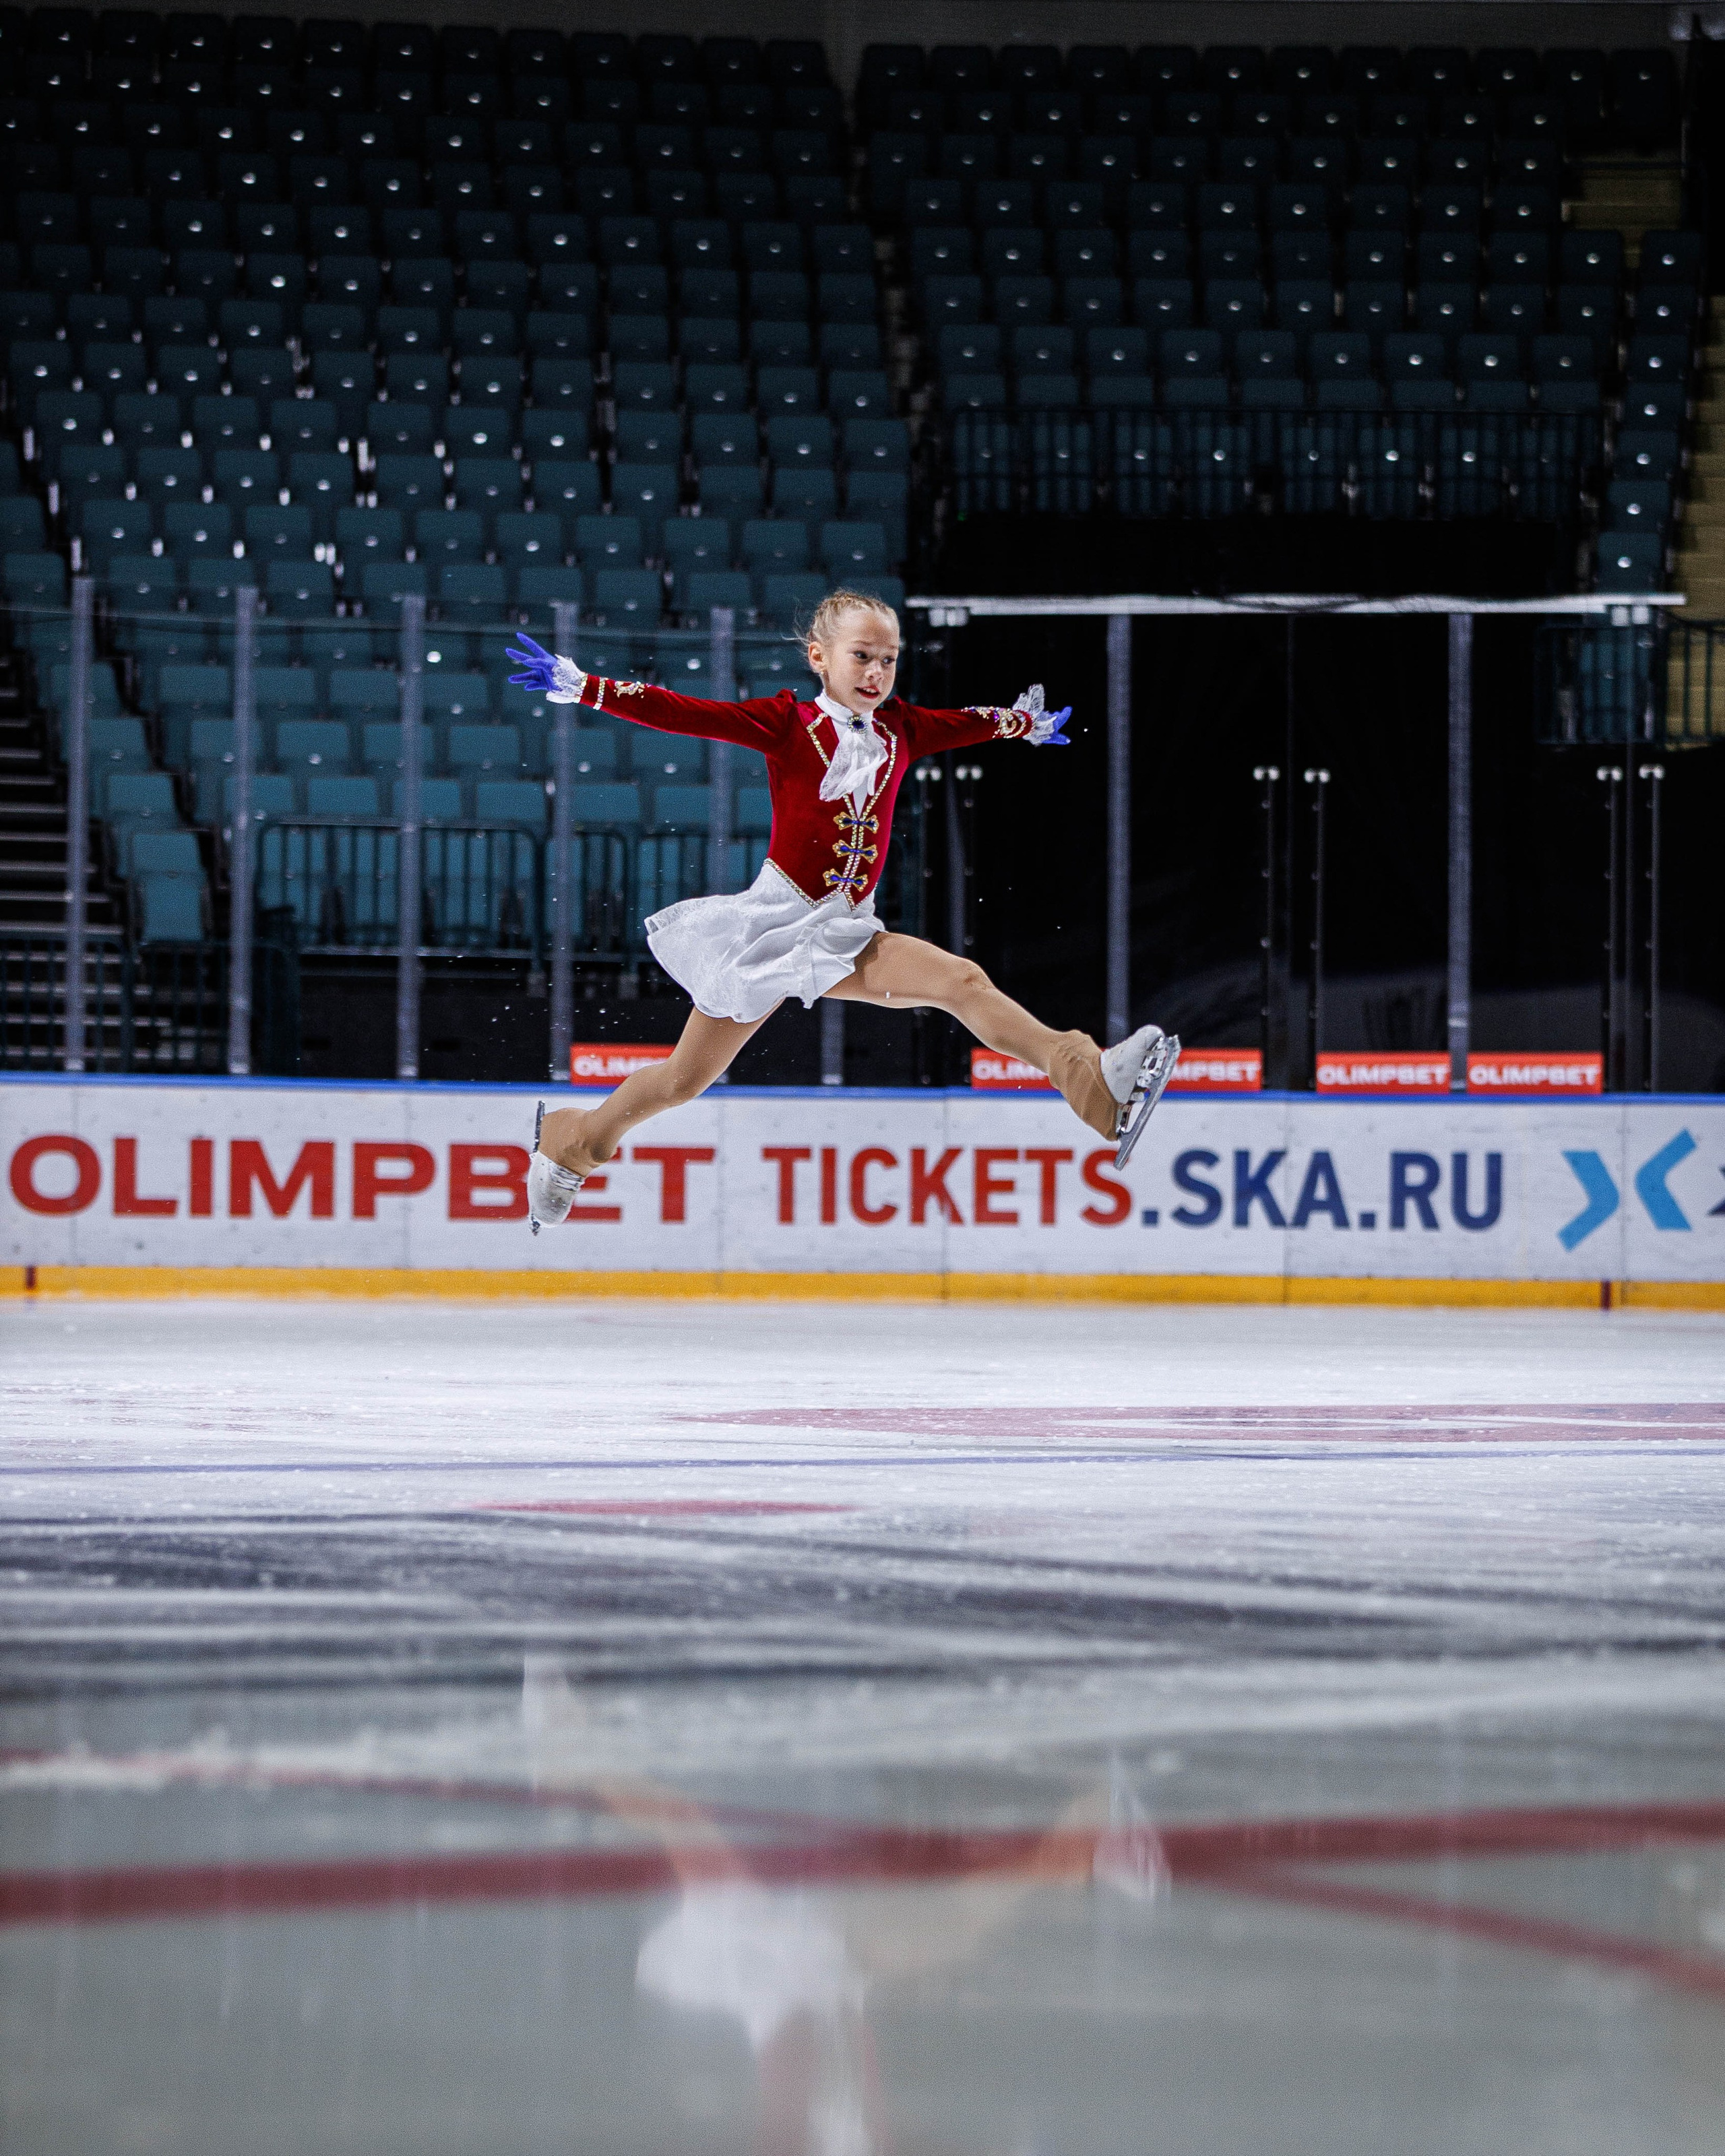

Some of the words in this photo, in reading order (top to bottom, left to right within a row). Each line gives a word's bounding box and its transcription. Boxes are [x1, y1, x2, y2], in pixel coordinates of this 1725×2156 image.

[1316, 1063, 1449, 1085] OLIMPBET
[1469, 1064, 1600, 1085] OLIMPBET
[762, 1147, 1503, 1232] TICKETS.SKA.RU
